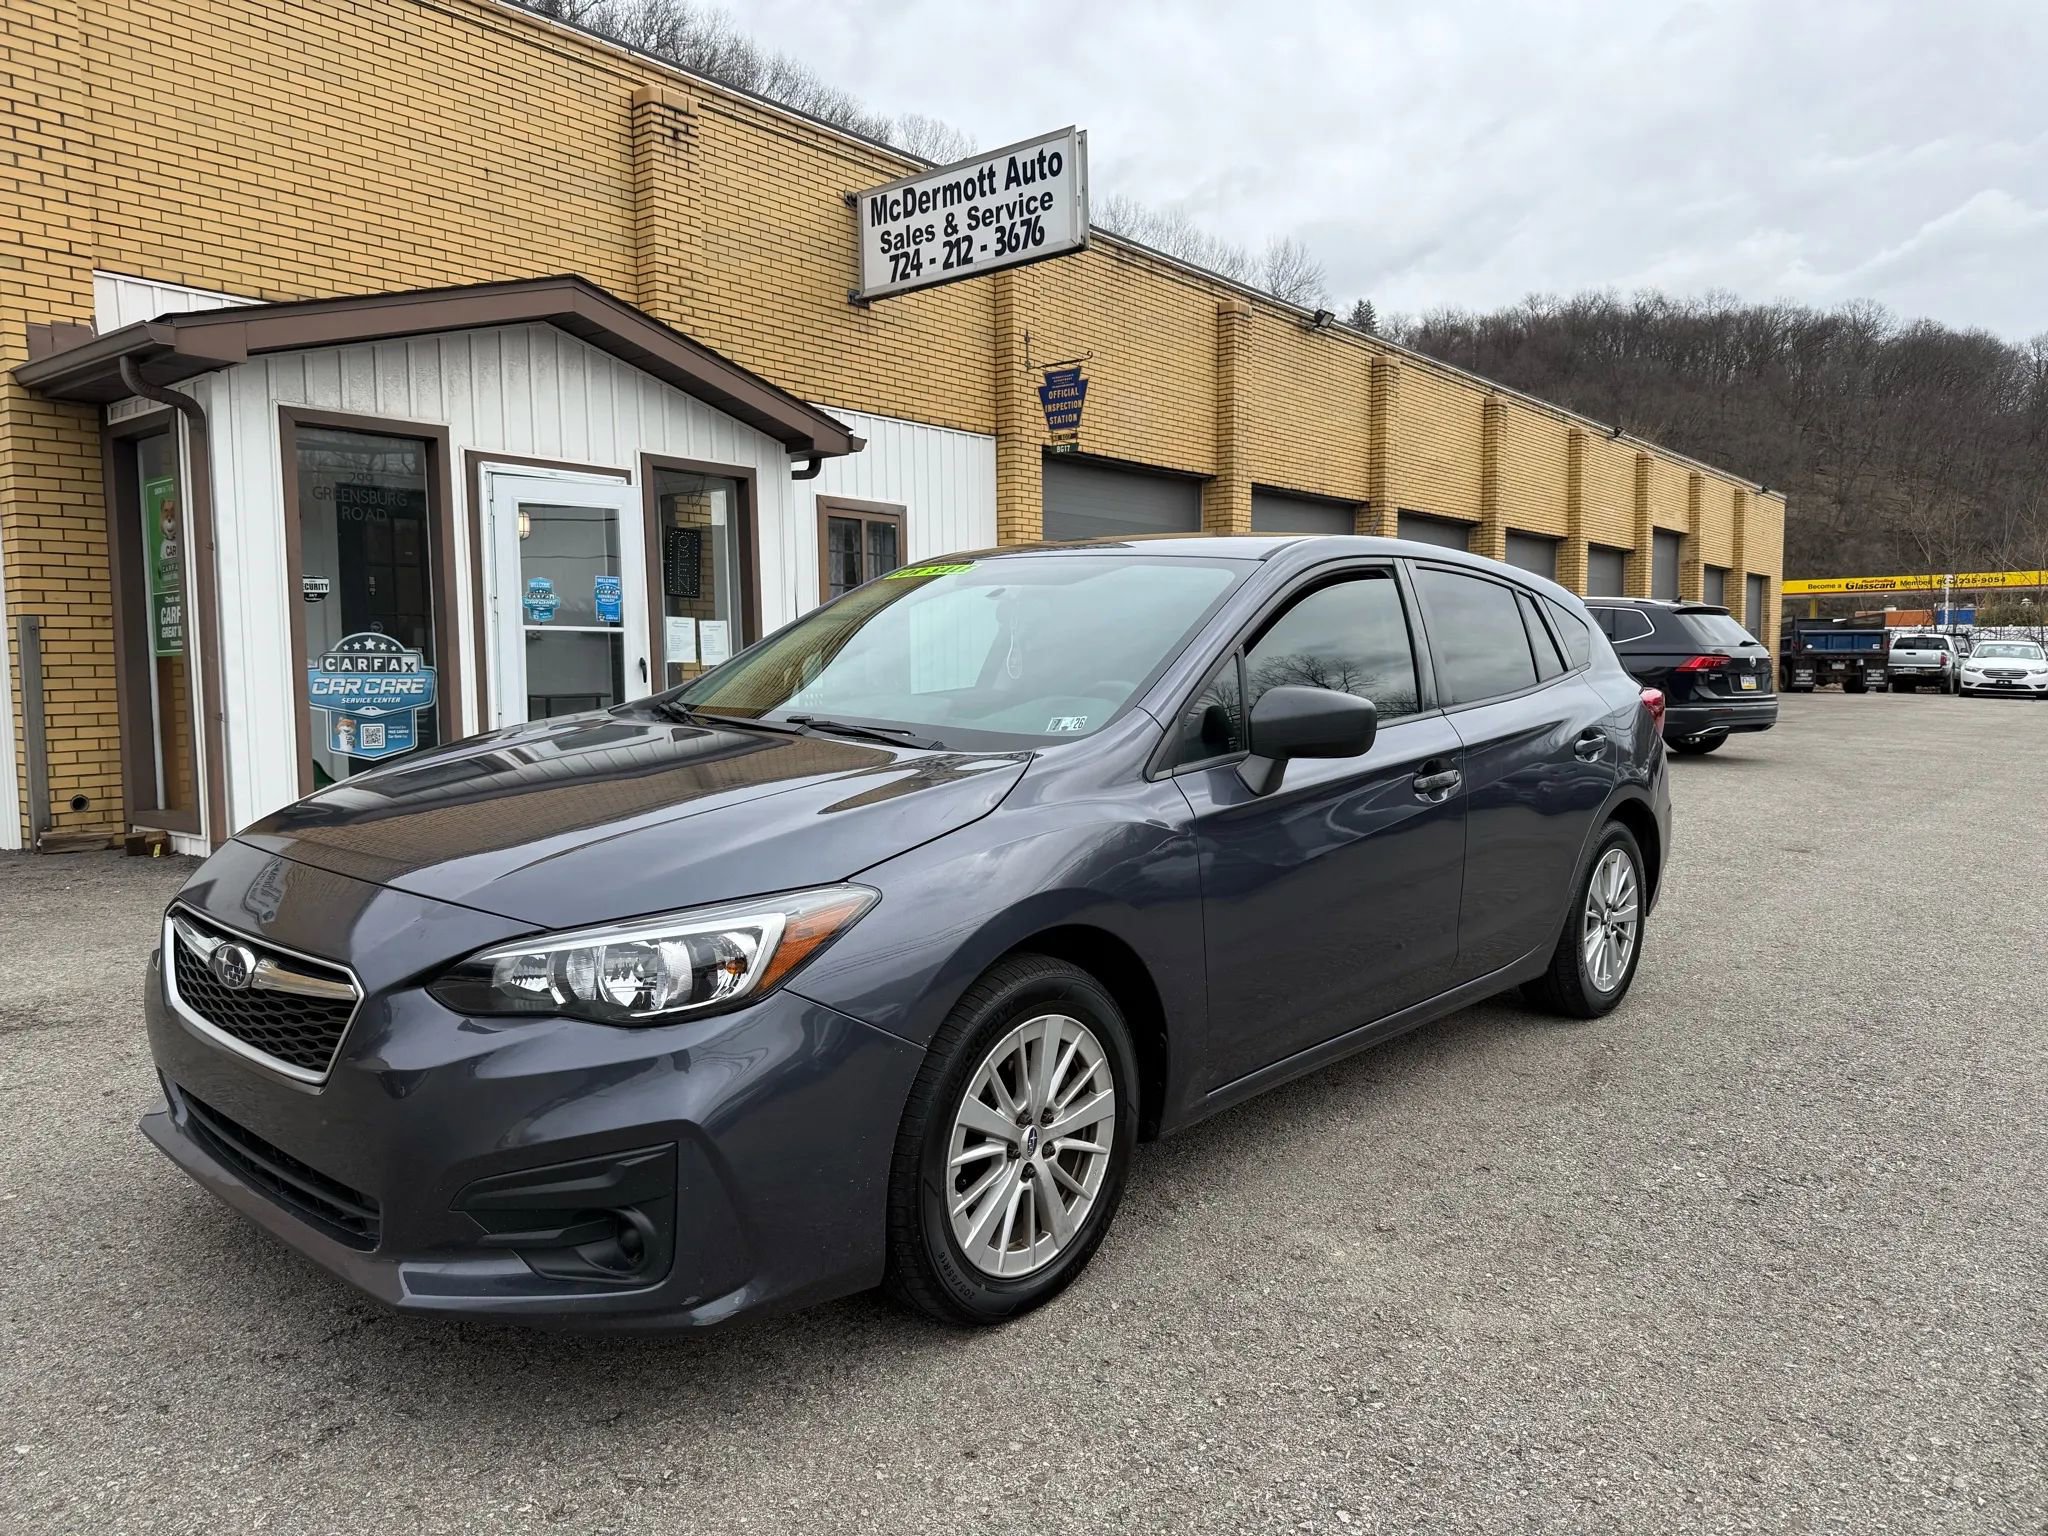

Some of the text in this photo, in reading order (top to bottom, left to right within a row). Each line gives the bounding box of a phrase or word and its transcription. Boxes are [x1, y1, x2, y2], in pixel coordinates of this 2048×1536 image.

[871, 148, 1063, 227] McDermott Auto
[880, 191, 1054, 255] Sales & Service
[889, 248, 923, 284] 724
[942, 234, 974, 271] 212
[994, 214, 1045, 257] 3676
[1048, 387, 1079, 400] OFFICIAL
[1045, 399, 1082, 413] INSPECTION
[1049, 413, 1077, 425] STATION
[351, 472, 374, 484] 299
[312, 485, 408, 506] GREENSBURG
[342, 506, 388, 522] ROAD
[677, 534, 691, 593] OPEN
[1845, 581, 1896, 590] Glasscard
[162, 626, 177, 638] GREAT
[324, 657, 415, 673] CARFAX
[312, 678, 426, 695] CAR CARE
[1073, 718, 1085, 728] 26
[938, 1250, 976, 1301] 205/55R16
